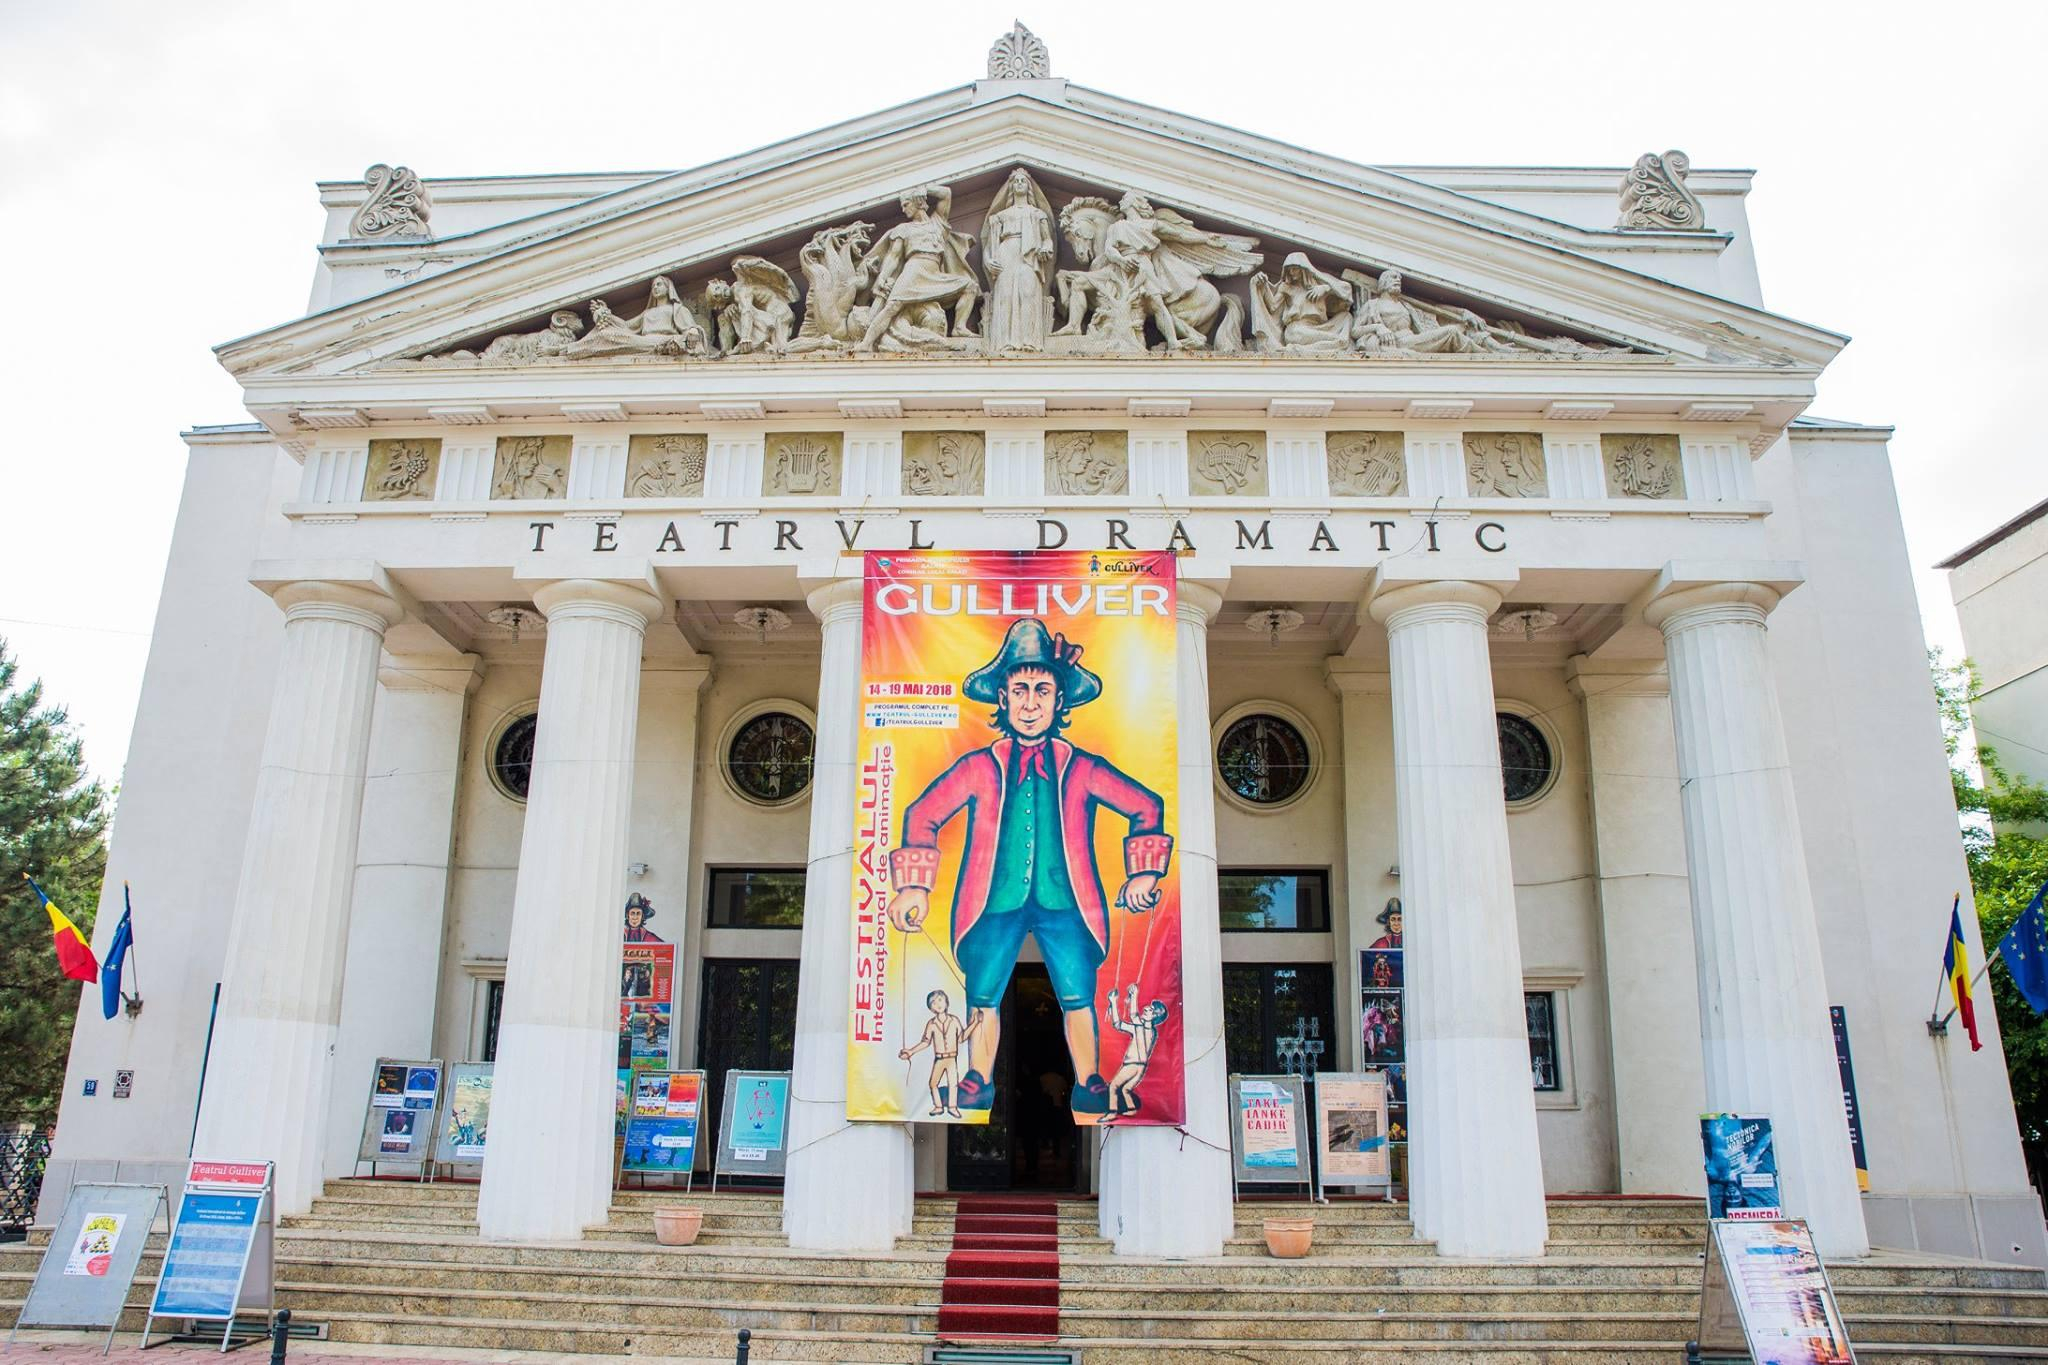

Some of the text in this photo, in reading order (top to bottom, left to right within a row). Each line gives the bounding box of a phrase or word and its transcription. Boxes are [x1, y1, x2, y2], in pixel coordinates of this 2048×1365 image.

[530, 519, 1507, 552] TEATRVL DRAMATIC
[875, 583, 1169, 617] GULLIVER
[869, 684, 880, 695] 14
[889, 683, 901, 695] 19
[903, 683, 923, 695] MAI
[926, 684, 952, 696] 2018
[876, 854, 888, 882] de
[855, 747, 879, 1042] FESTIVALUL
[194, 1164, 267, 1177] Teatrul Gulliver
